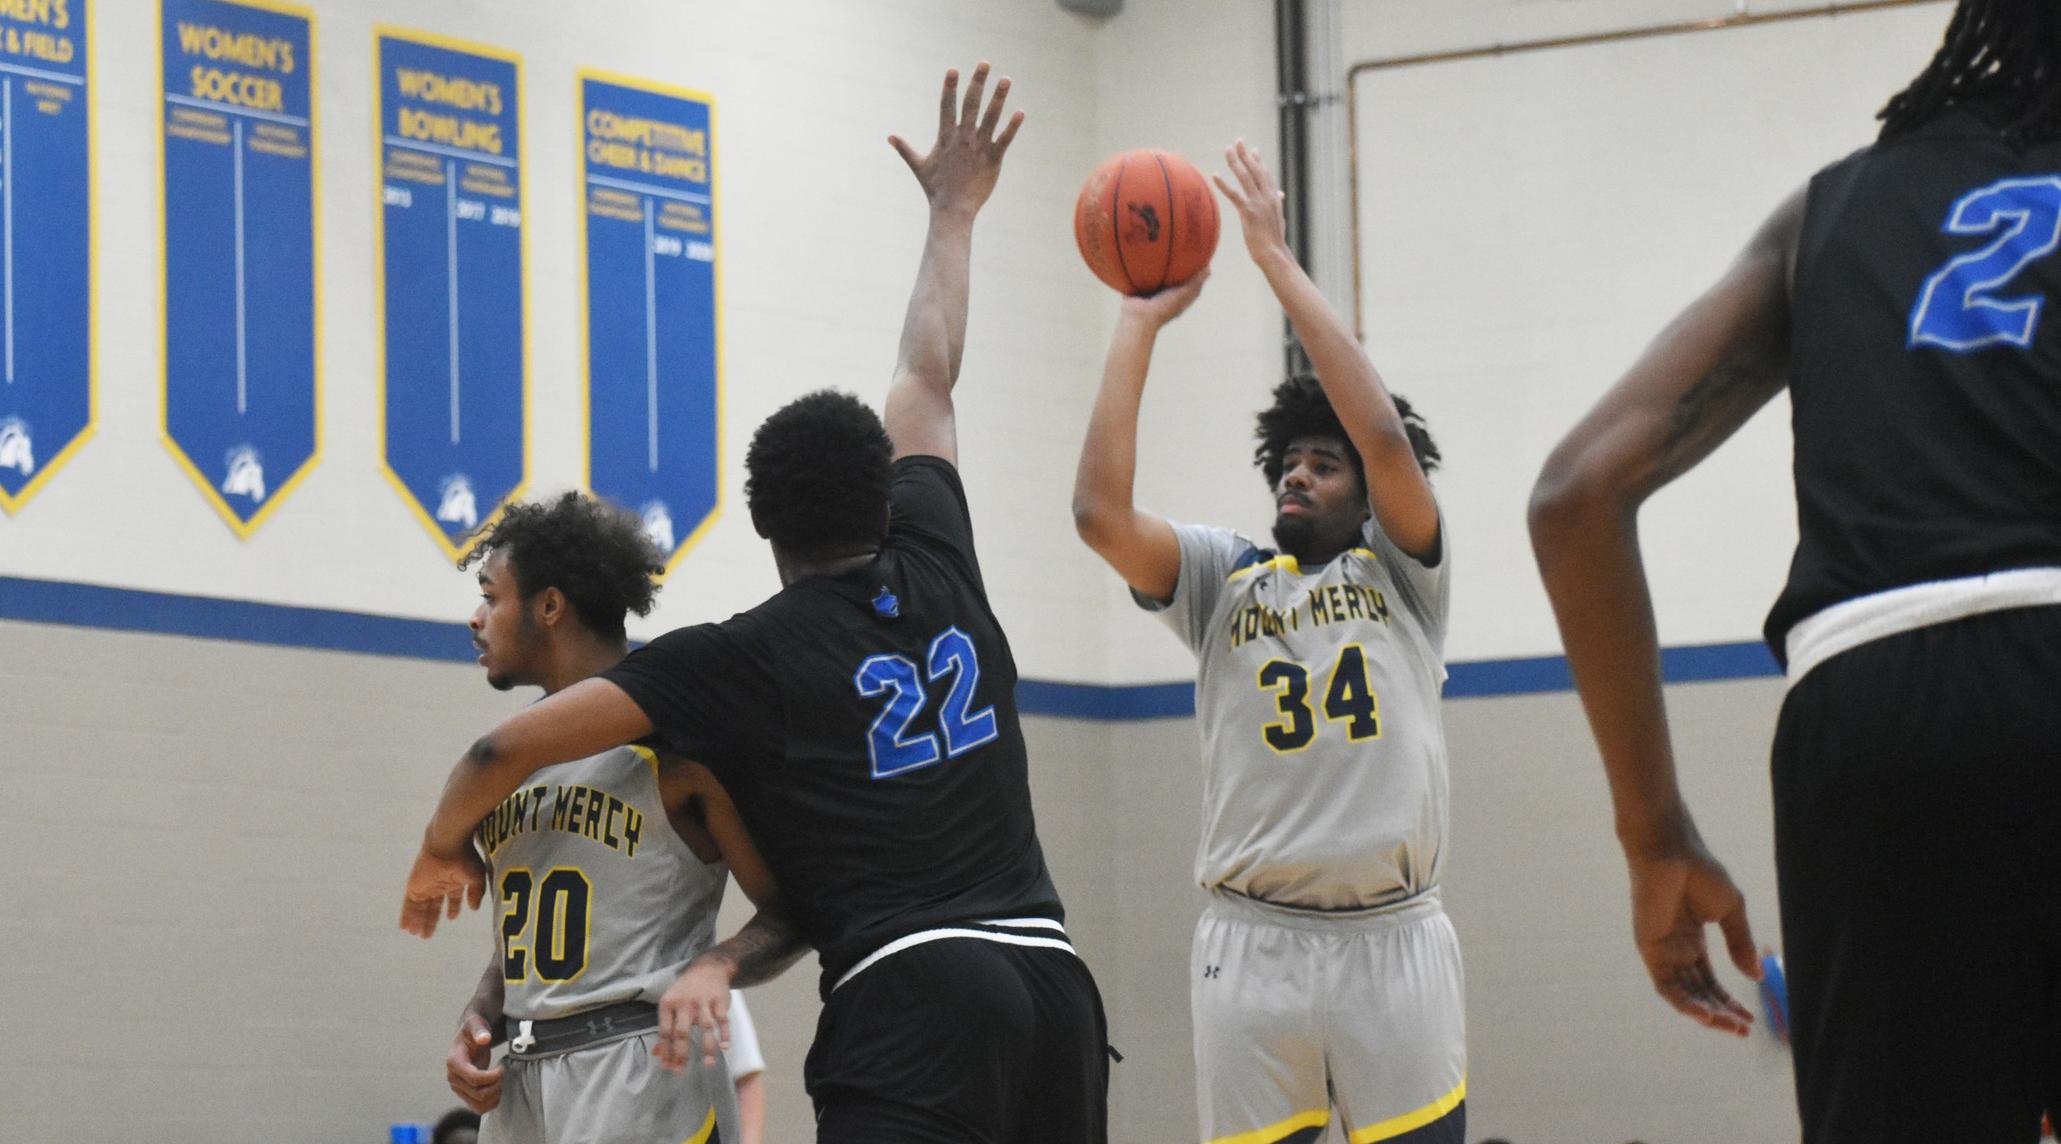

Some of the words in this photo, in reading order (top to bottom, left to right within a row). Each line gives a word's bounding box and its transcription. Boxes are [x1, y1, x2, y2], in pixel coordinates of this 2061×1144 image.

[24, 31, 74, 63] FIELD
[177, 22, 294, 74] WOMEN'S
[191, 66, 283, 112] SOCCER
[397, 69, 502, 114] WOMEN'S
[400, 108, 501, 154] BOWLING
[1907, 173, 2061, 351] 2
[1307, 583, 1391, 628] MERCY
[854, 624, 999, 779] 22
[1258, 642, 1381, 754] 34
[549, 784, 643, 858] MERCY
[501, 865, 592, 985] 20
